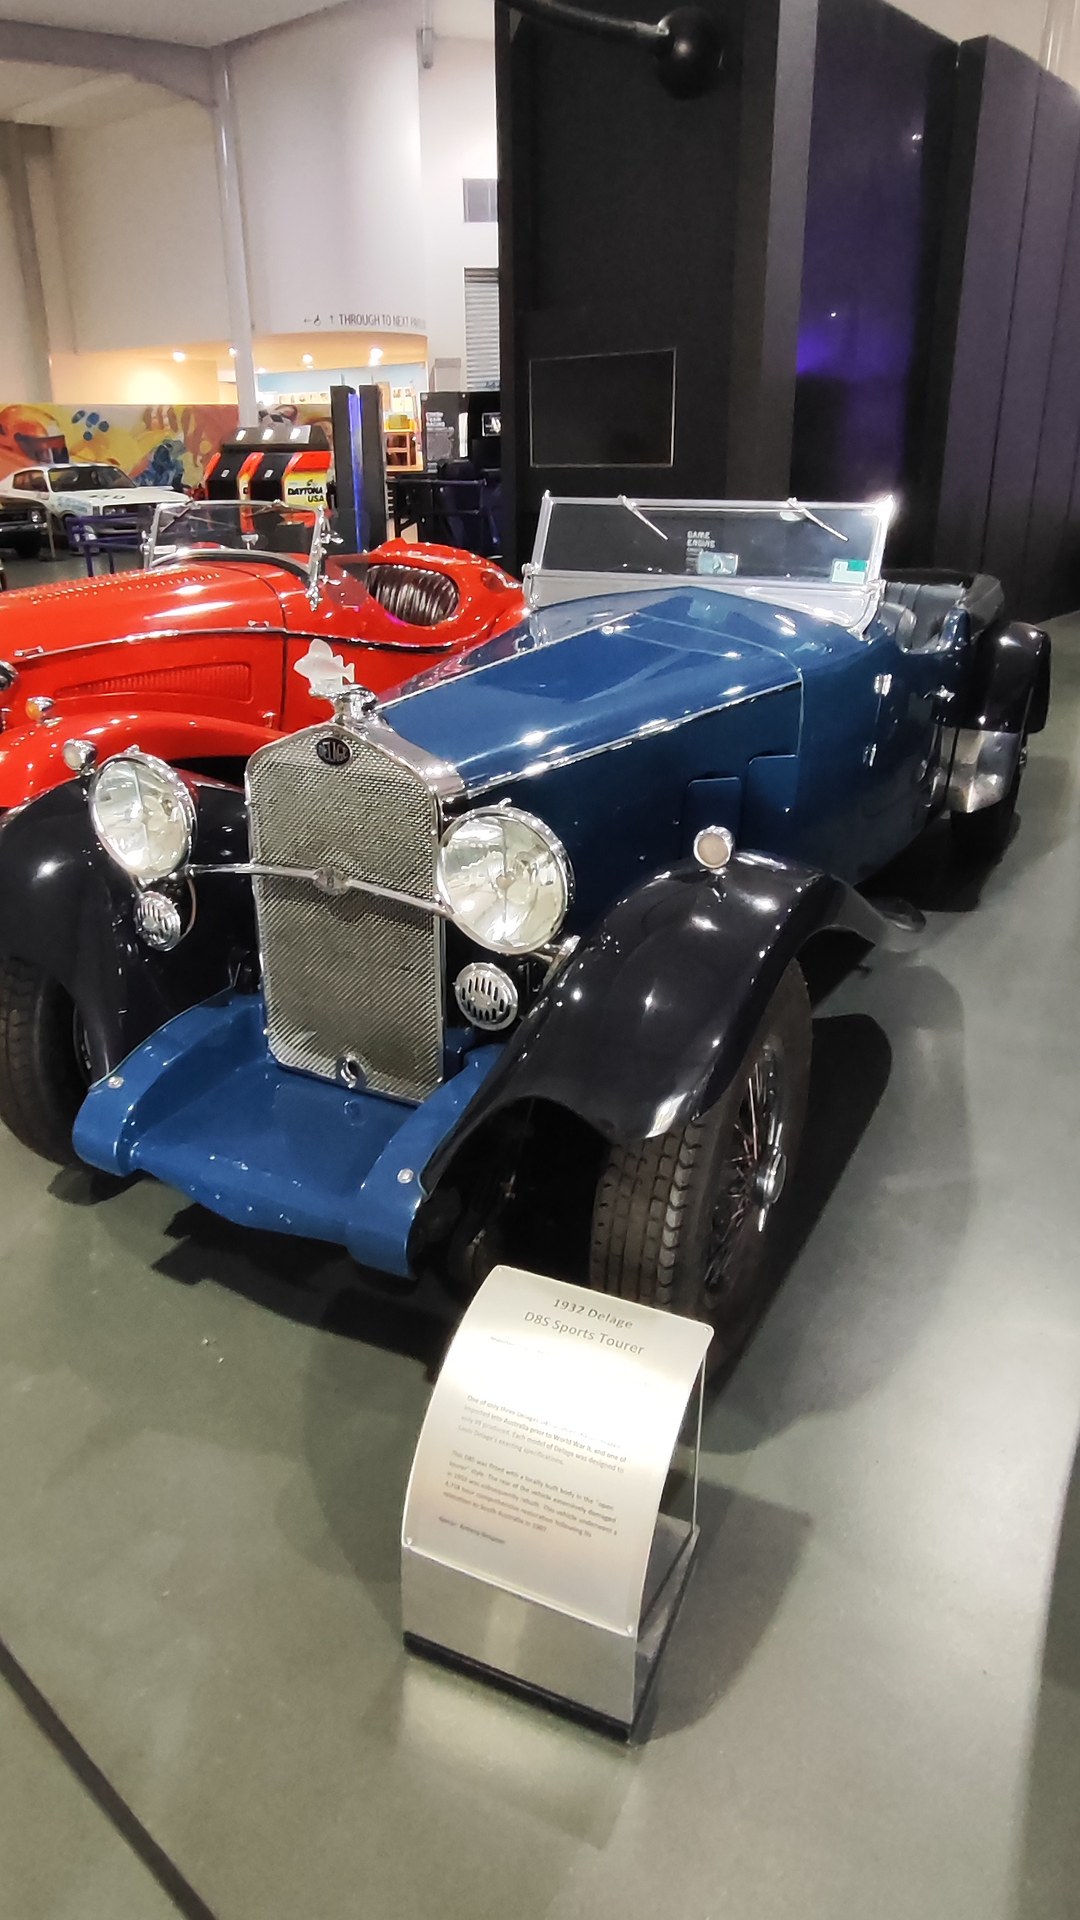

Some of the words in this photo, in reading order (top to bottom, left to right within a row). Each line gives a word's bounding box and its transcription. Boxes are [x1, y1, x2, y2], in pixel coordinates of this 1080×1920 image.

[339, 313, 380, 326] THROUGH
[382, 315, 392, 327] TO
[287, 487, 323, 496] DAYTONA
[307, 495, 324, 503] USA
[687, 530, 711, 539] GAME
[554, 1299, 585, 1315] 1932
[587, 1308, 633, 1329] Delage
[524, 1311, 550, 1327] D8S
[552, 1319, 595, 1341] Sports
[599, 1332, 644, 1354] Tourer
[486, 1402, 499, 1410] only
[500, 1406, 515, 1414] three
[463, 1405, 489, 1418] imported
[503, 1418, 529, 1430] Australia
[529, 1427, 544, 1436] prior
[553, 1434, 571, 1444] World
[572, 1441, 585, 1449] War
[498, 1438, 522, 1451] exacting
[511, 1432, 525, 1440] Each
[526, 1437, 545, 1447] model
[553, 1446, 574, 1457] Delage
[587, 1457, 616, 1472] designed
[488, 1463, 504, 1472] fitted
[505, 1469, 518, 1477] with
[524, 1476, 543, 1487] locally
[544, 1483, 558, 1491] built
[559, 1488, 575, 1497] body
[531, 1489, 551, 1500] vehicle
[587, 1509, 616, 1524] damaged
